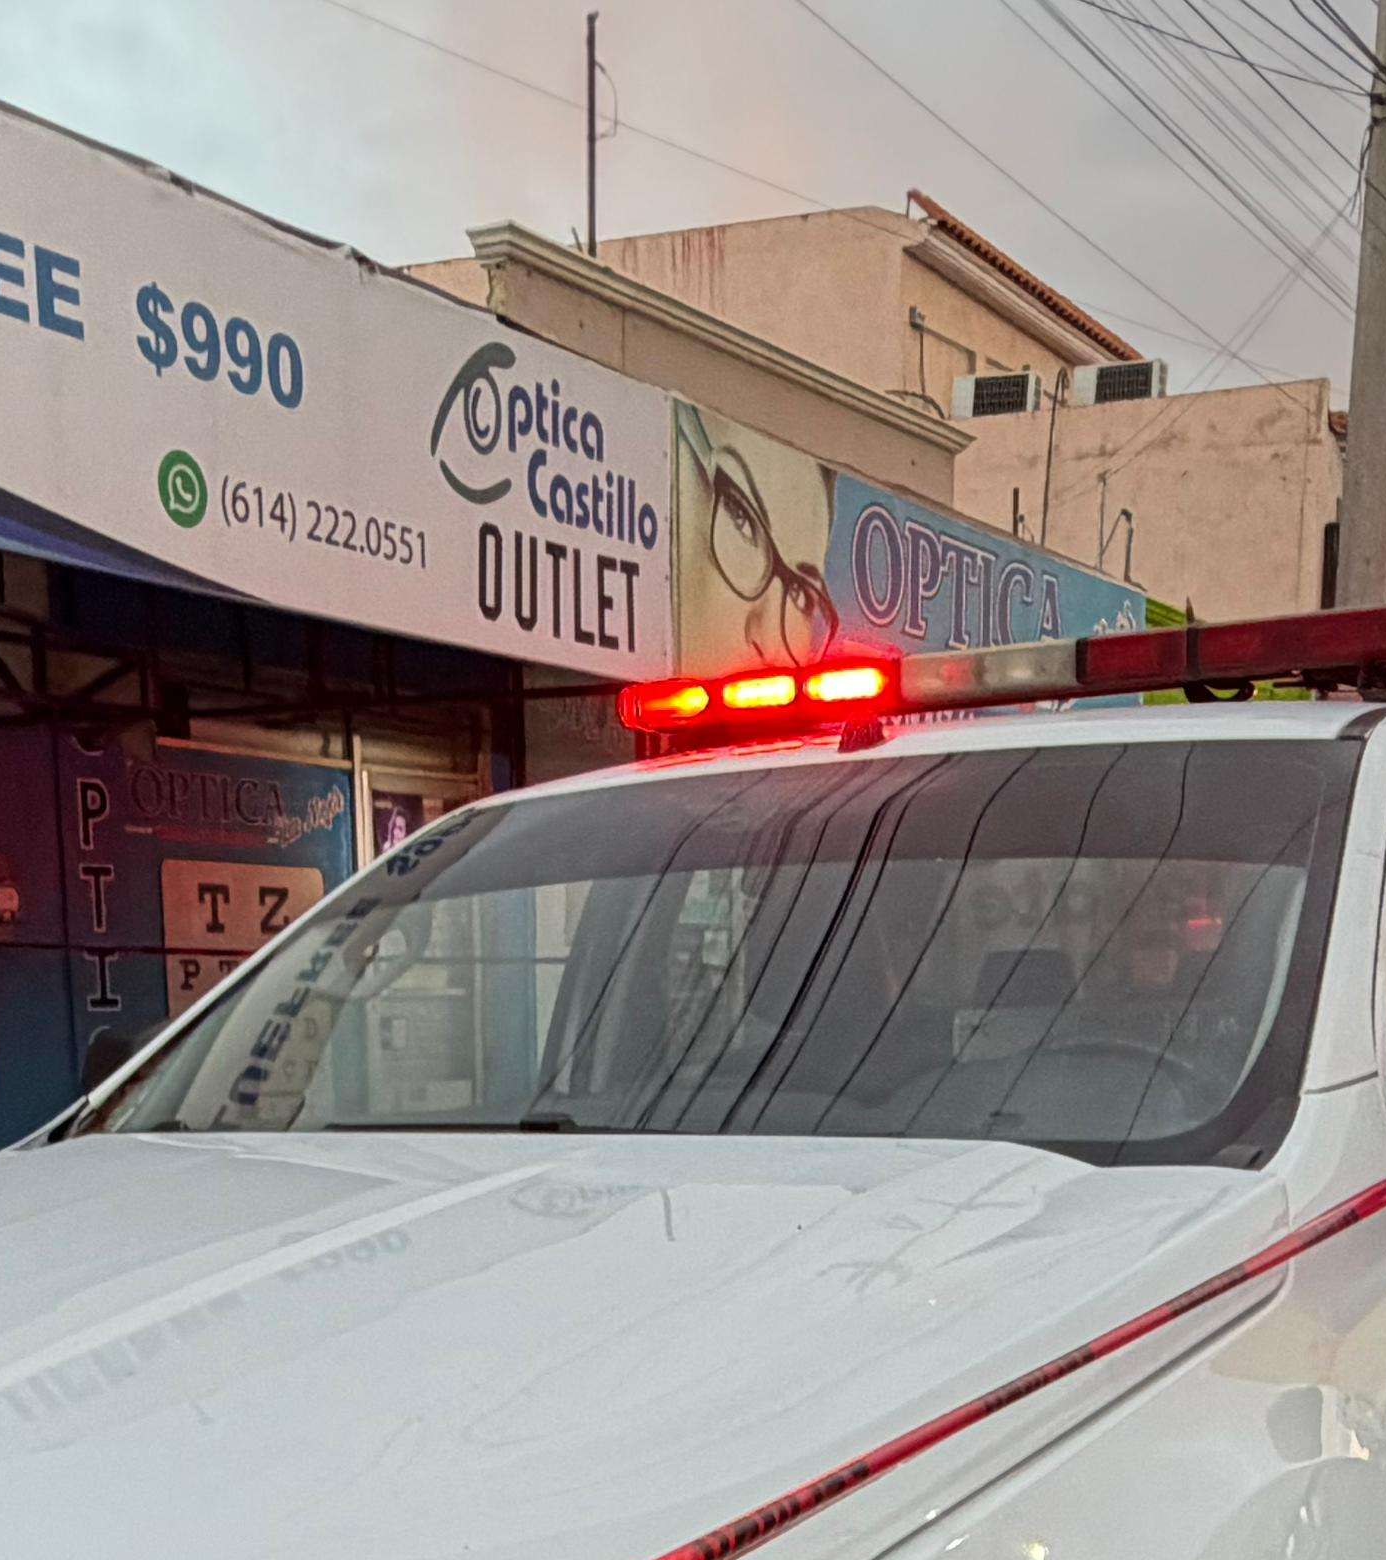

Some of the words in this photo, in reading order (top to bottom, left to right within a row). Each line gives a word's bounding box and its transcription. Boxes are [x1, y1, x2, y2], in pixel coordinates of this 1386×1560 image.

[136, 281, 304, 410] $990
[221, 475, 297, 543] (614)
[307, 500, 427, 569] 222.0551
[528, 449, 658, 549] Castillo
[479, 522, 640, 653] OUTLET
[852, 505, 1062, 650] OPTICA
[130, 765, 284, 826] OPTICA
